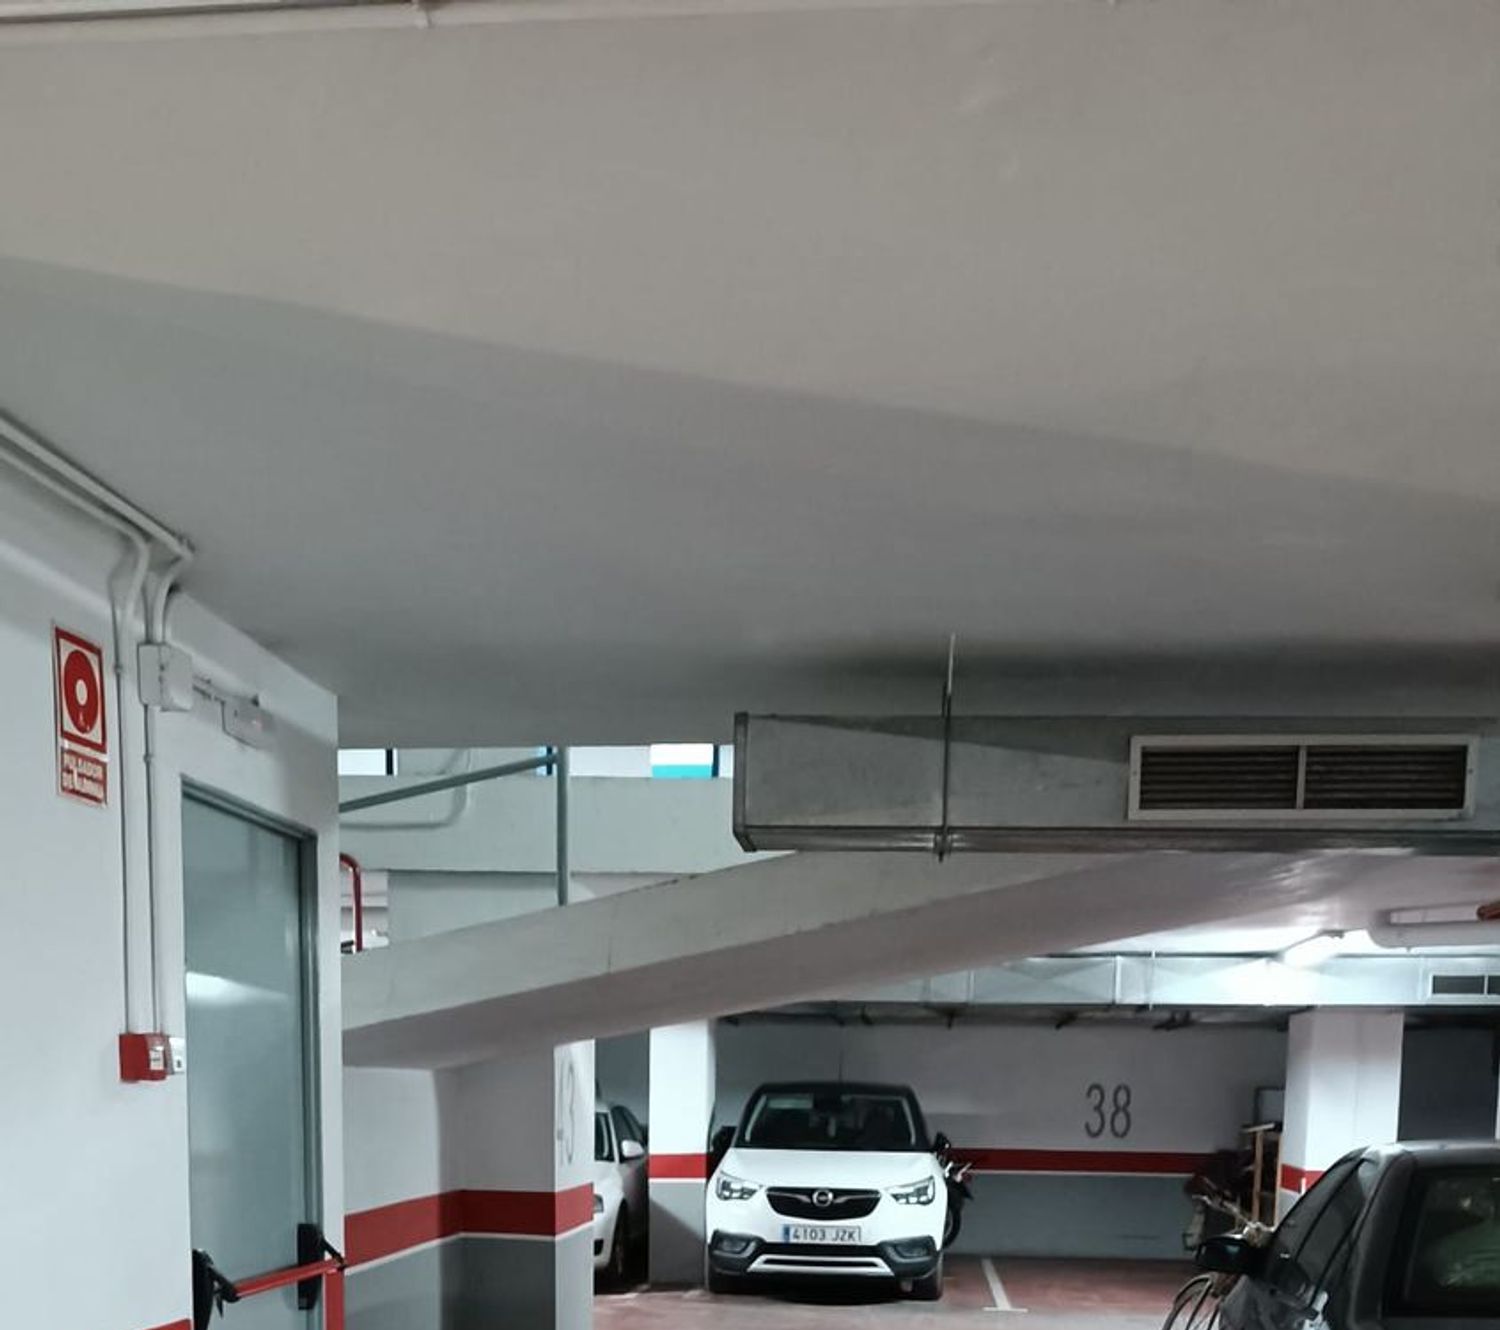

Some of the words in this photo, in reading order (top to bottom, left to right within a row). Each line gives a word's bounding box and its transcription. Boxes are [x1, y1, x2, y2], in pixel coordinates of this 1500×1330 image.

[1085, 1083, 1131, 1138] 38
[793, 1227, 826, 1241] 4103
[832, 1228, 857, 1242] JZK
